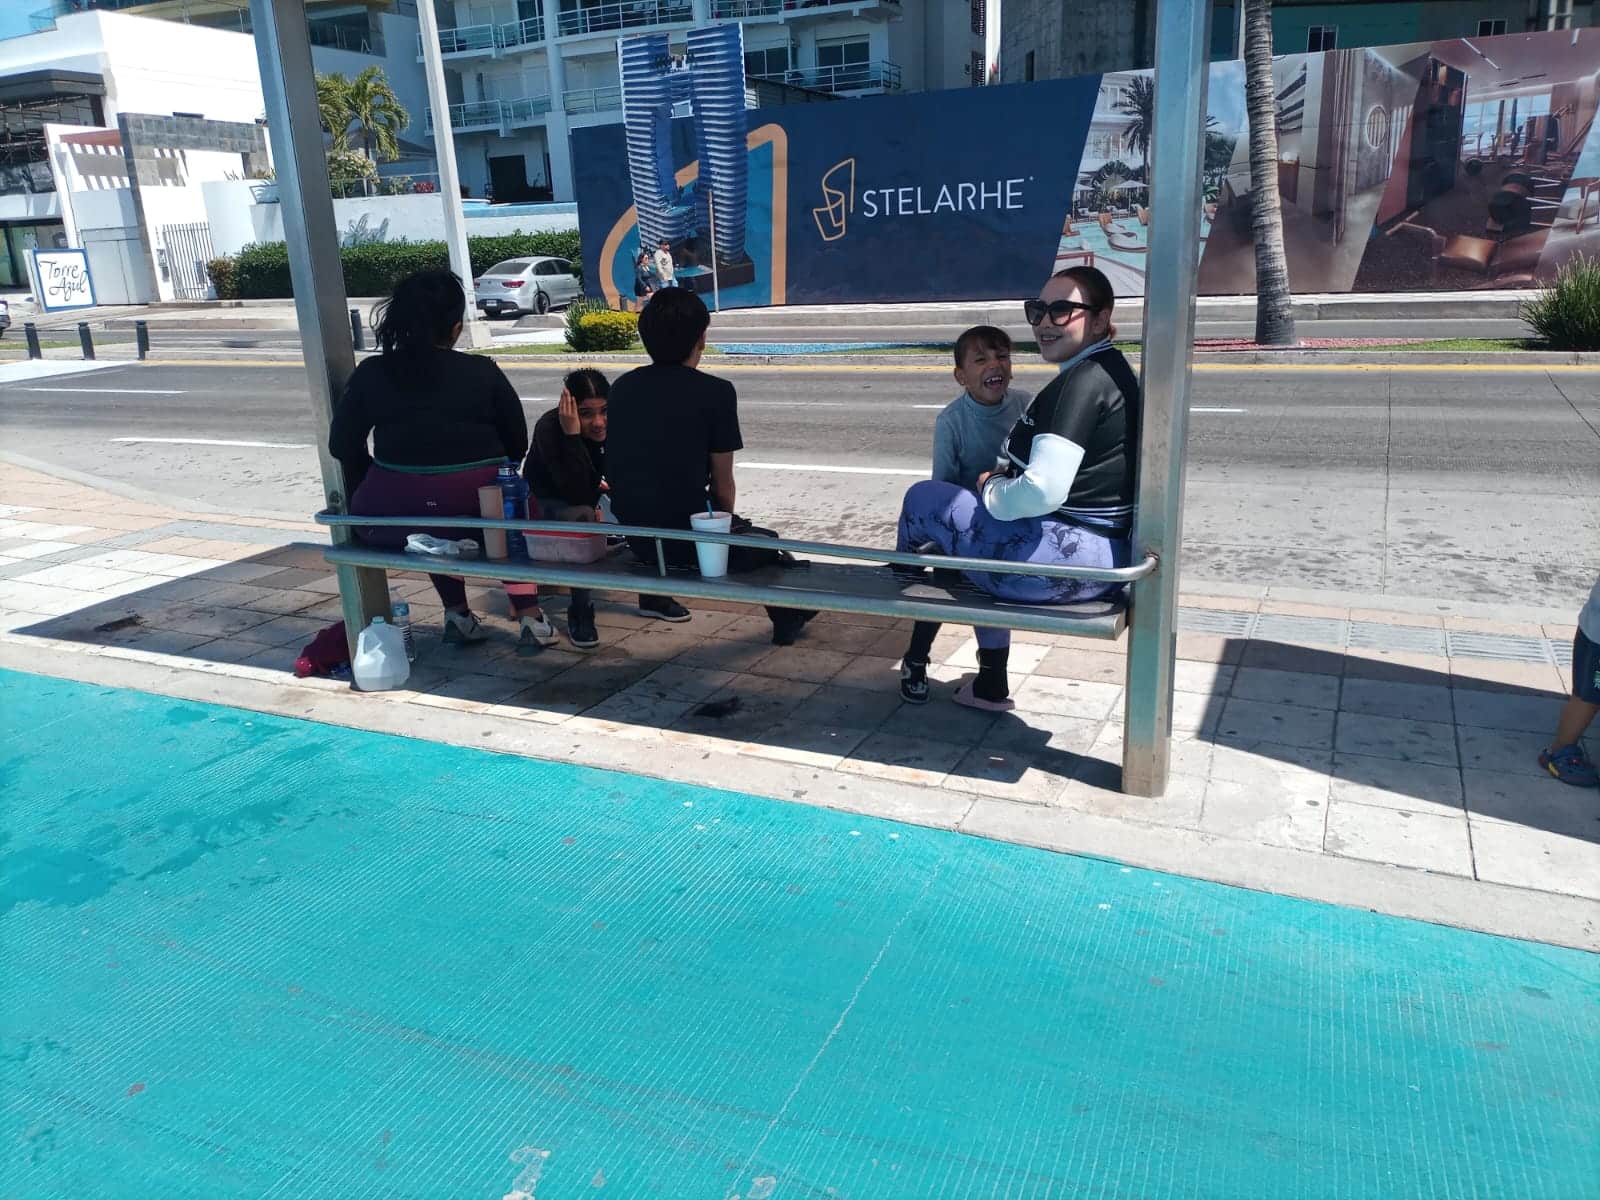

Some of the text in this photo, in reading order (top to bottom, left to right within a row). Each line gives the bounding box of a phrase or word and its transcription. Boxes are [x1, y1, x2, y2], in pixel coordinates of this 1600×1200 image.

[863, 178, 1025, 217] STELARHE
[39, 260, 79, 280] Torre
[49, 270, 88, 301] Azul
